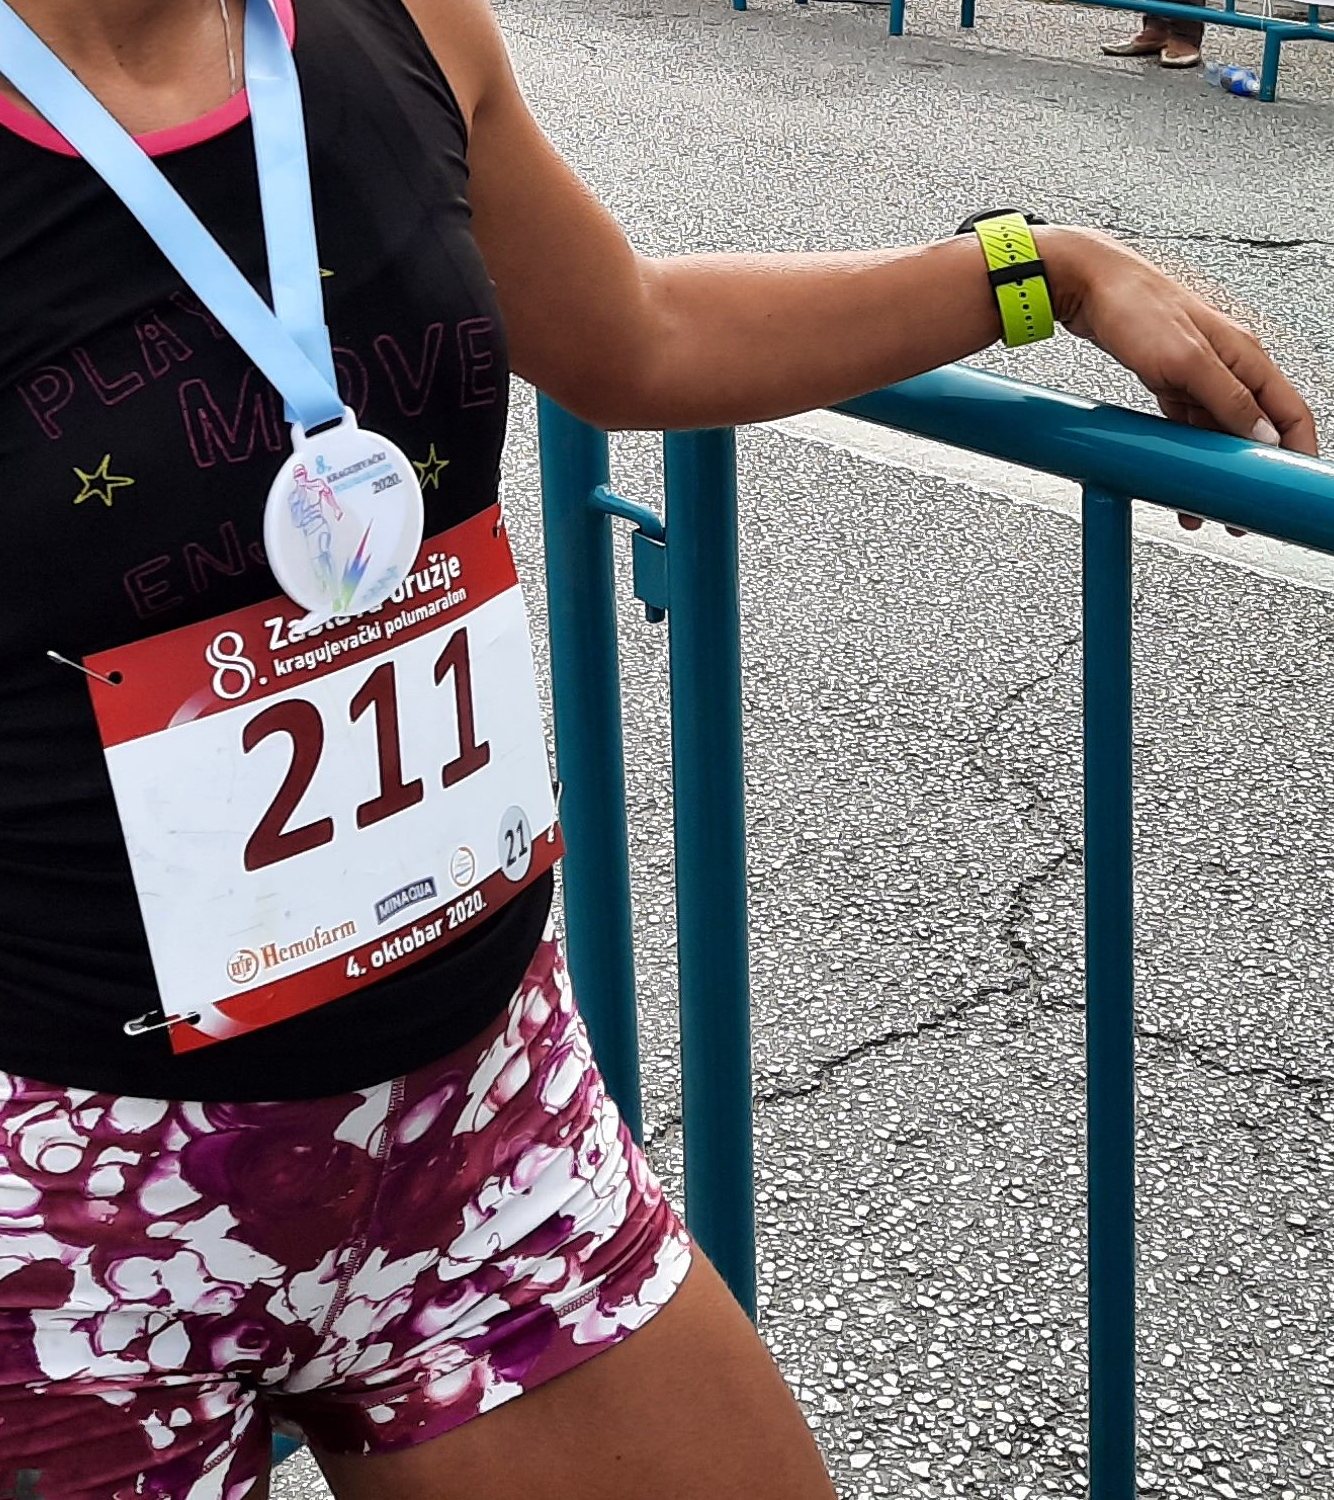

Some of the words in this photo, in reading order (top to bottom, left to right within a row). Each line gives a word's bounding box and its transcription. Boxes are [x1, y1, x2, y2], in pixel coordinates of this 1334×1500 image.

[205, 631, 269, 700] 8.
[273, 621, 382, 676] kragujevački
[384, 587, 467, 639] polumaraton
[242, 625, 491, 874] 211
[504, 819, 528, 869] 21
[377, 879, 434, 919] MINAQUA
[261, 920, 358, 970] Hemofarm
[346, 955, 367, 978] 4.
[370, 918, 444, 970] oktobar
[445, 890, 488, 929] 2020.
